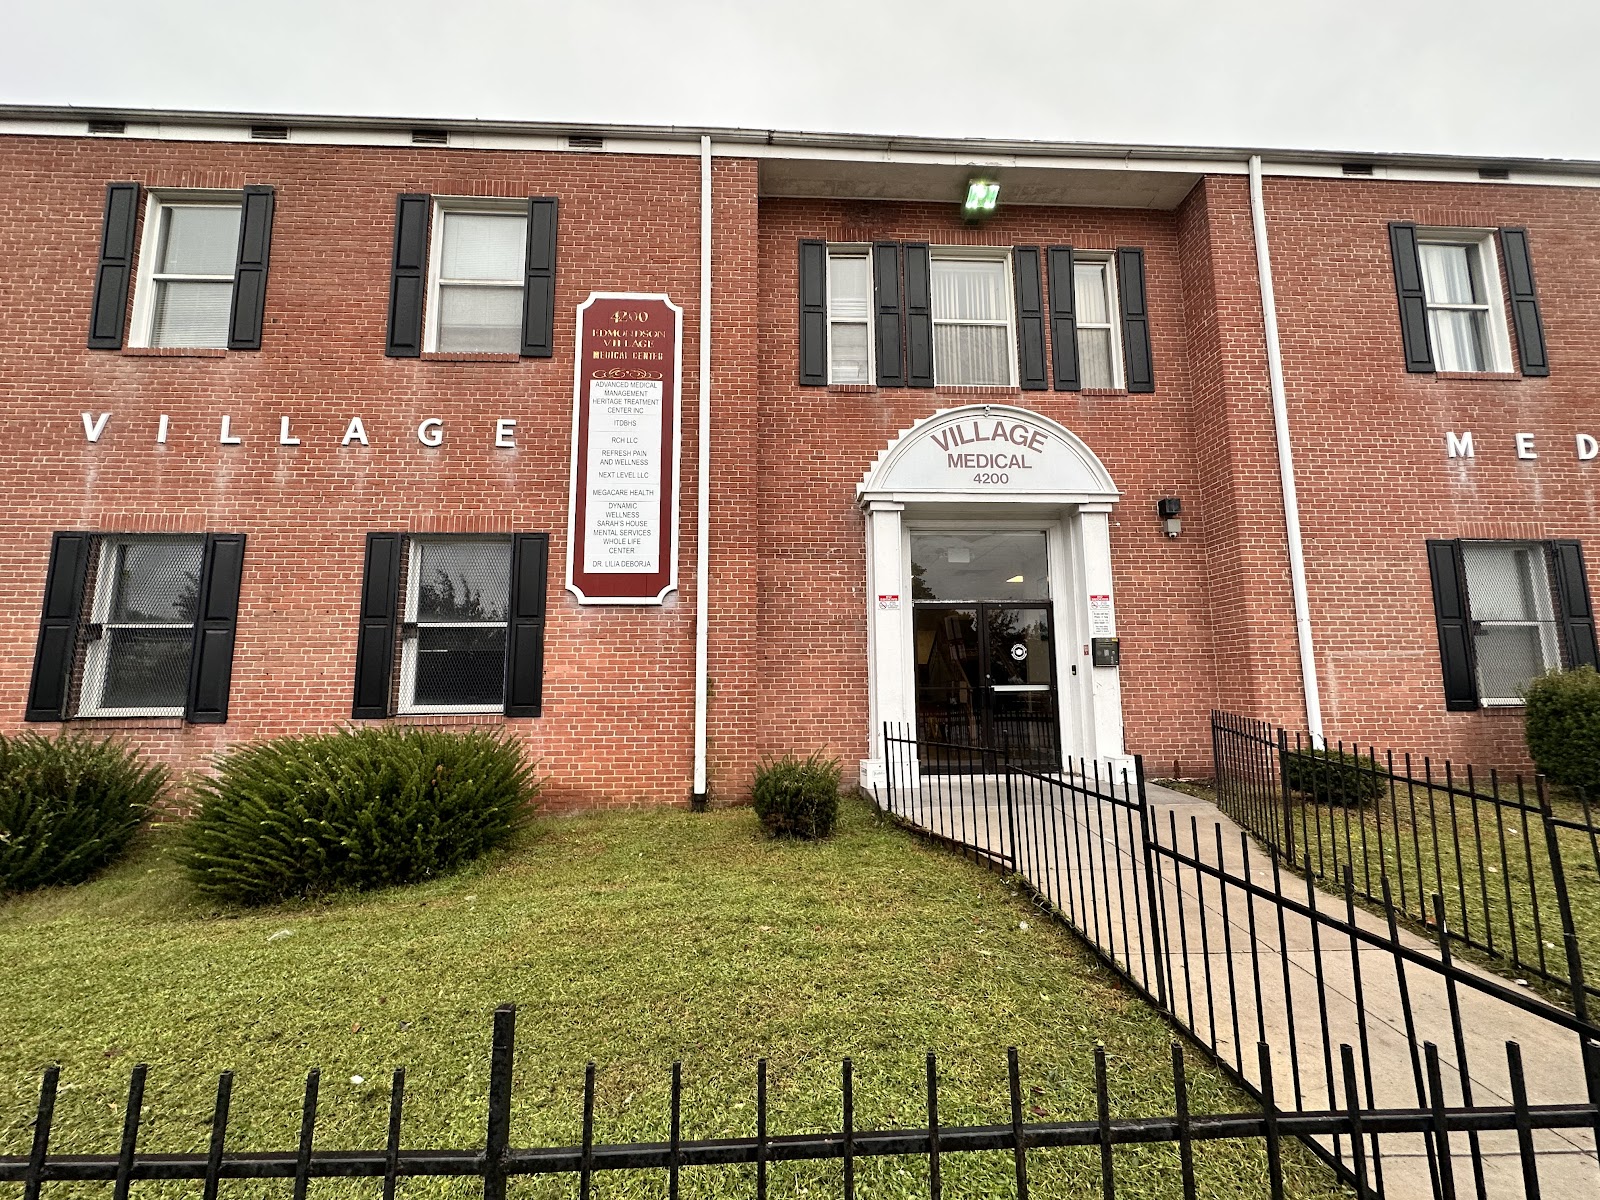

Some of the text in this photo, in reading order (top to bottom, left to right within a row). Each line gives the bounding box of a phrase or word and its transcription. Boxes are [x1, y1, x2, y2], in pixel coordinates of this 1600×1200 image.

[610, 310, 649, 323] 4200
[592, 328, 666, 338] EDMONDSON
[603, 340, 654, 348] VILLAGE
[592, 351, 664, 360] MEDICAL CENTER
[82, 411, 517, 448] VILLAGE
[930, 421, 1048, 454] VILLAGE
[947, 453, 1032, 468] MEDICAL
[973, 473, 1009, 484] 4200
